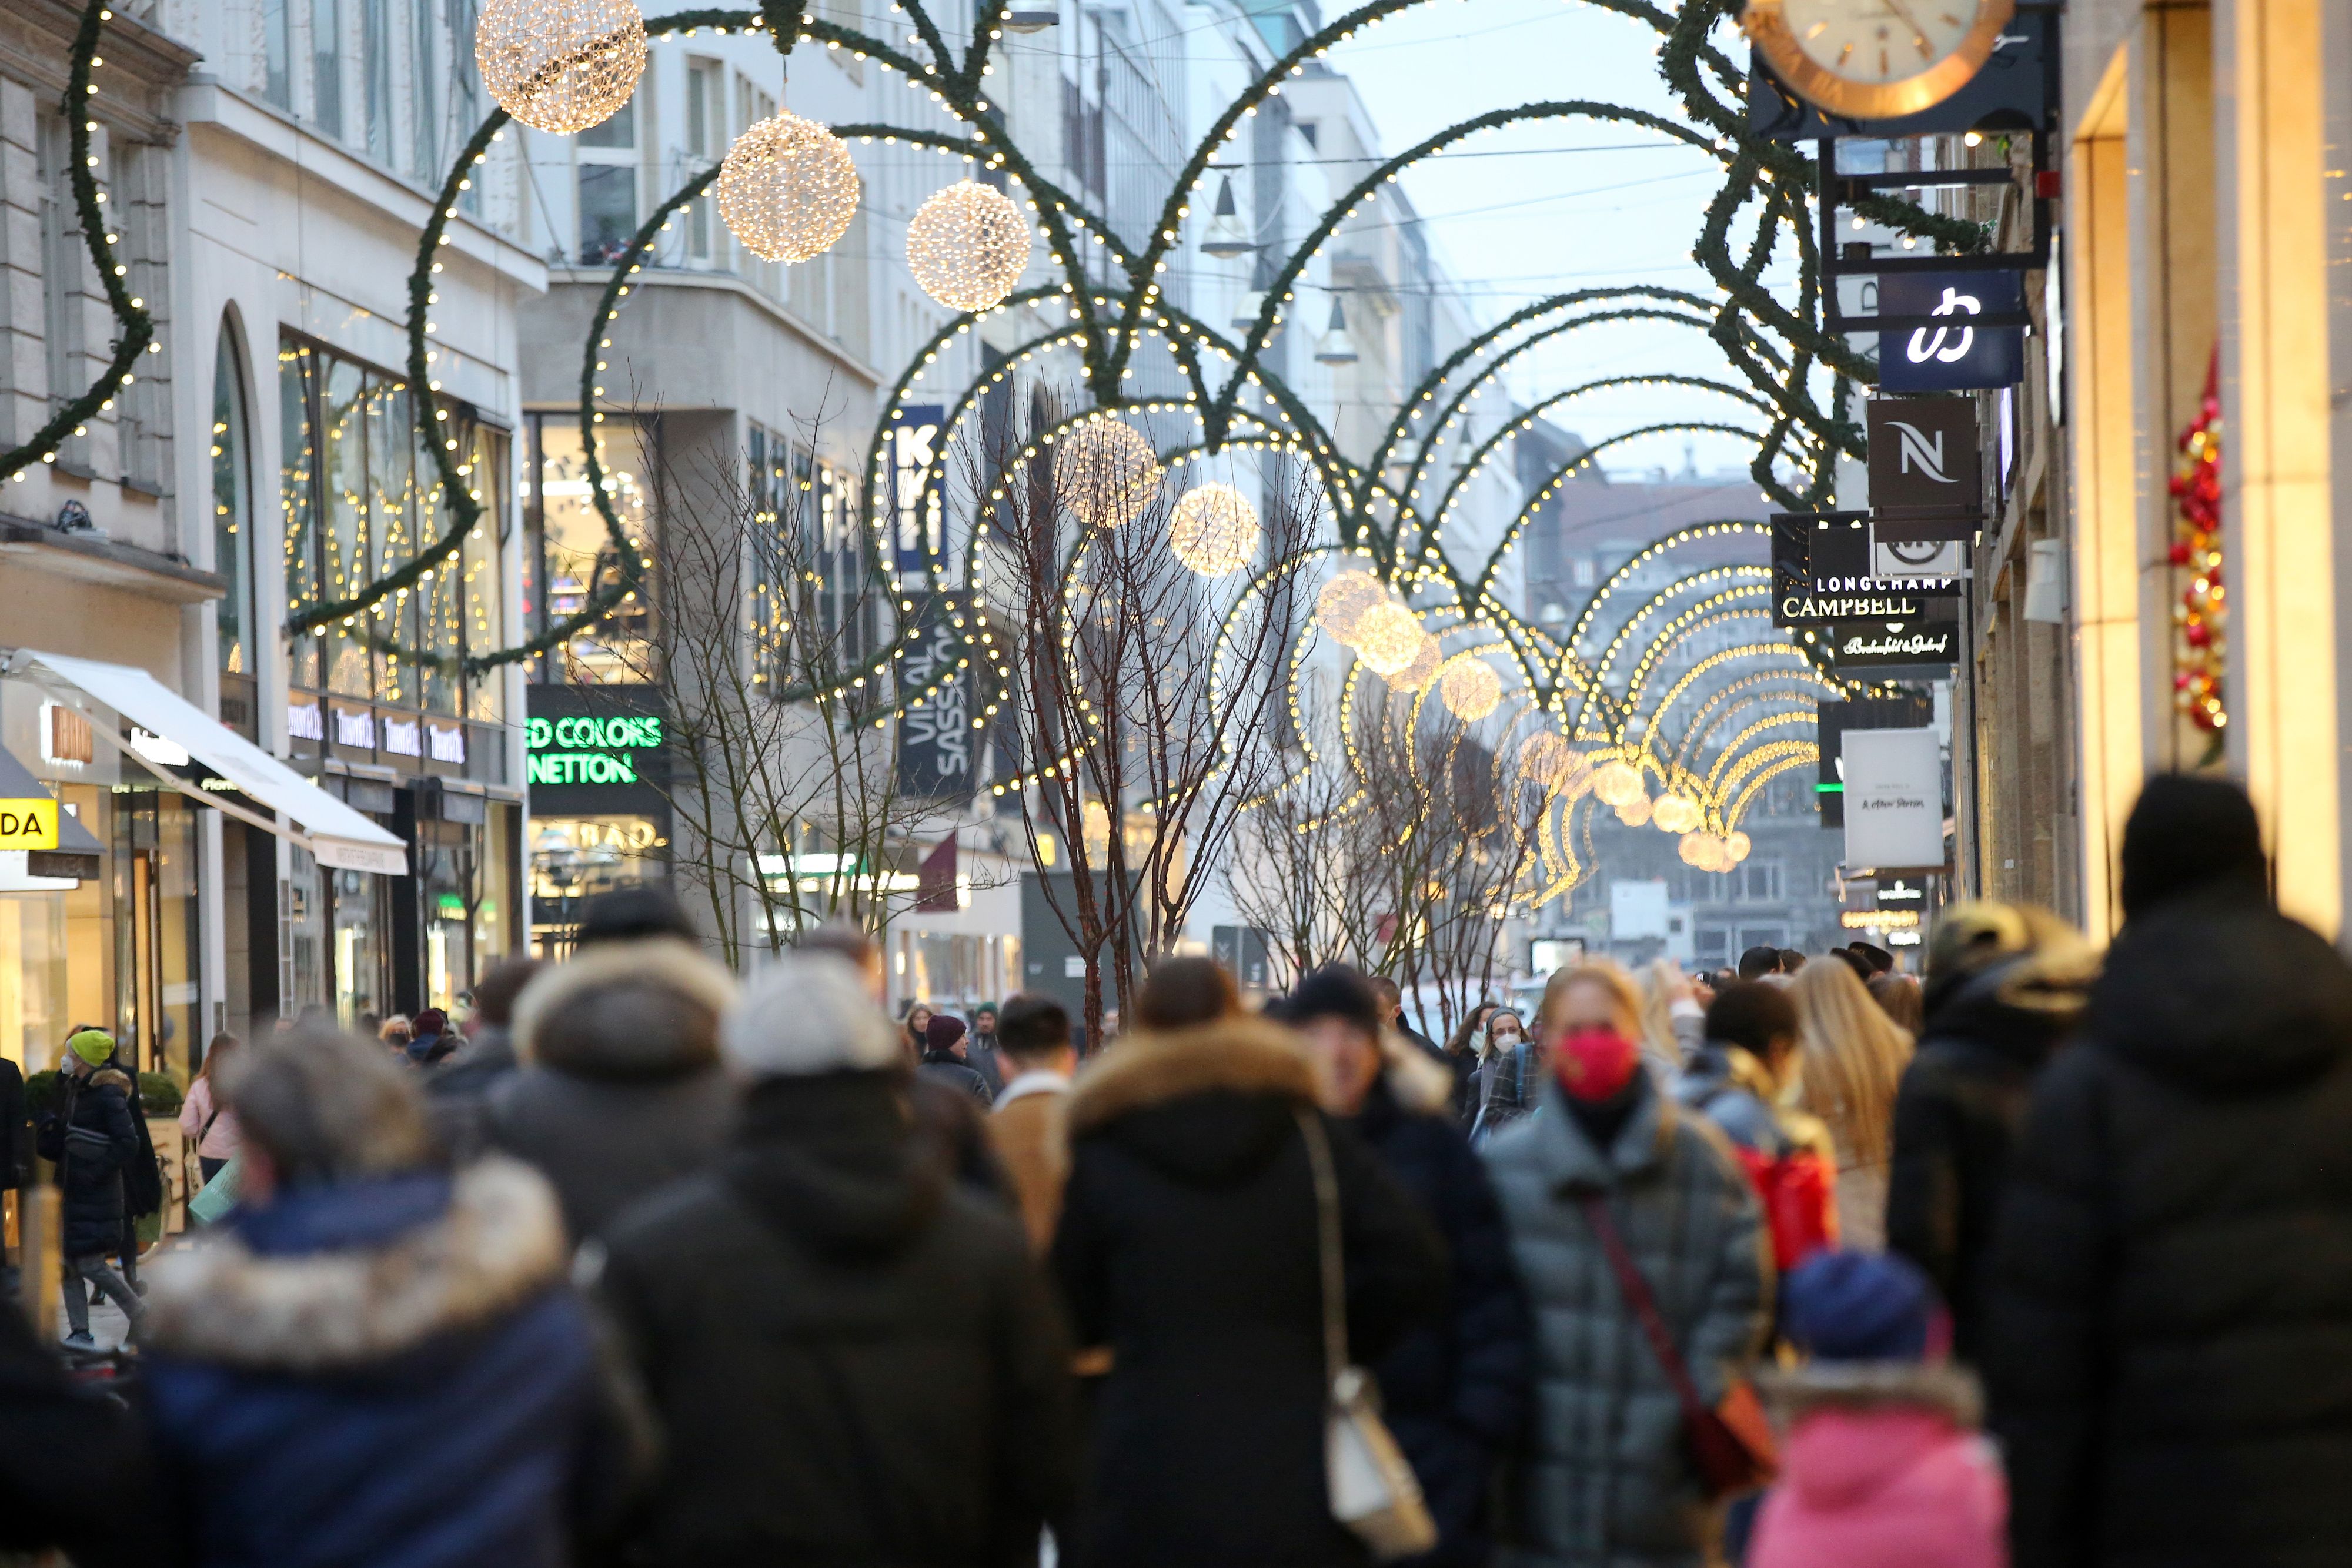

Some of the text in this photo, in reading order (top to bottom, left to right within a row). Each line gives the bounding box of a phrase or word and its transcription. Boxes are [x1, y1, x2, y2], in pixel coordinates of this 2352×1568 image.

[1816, 574, 1952, 593] LONGCHAMP
[1782, 596, 1916, 618] CAMPBELL
[1, 813, 42, 835] DA
